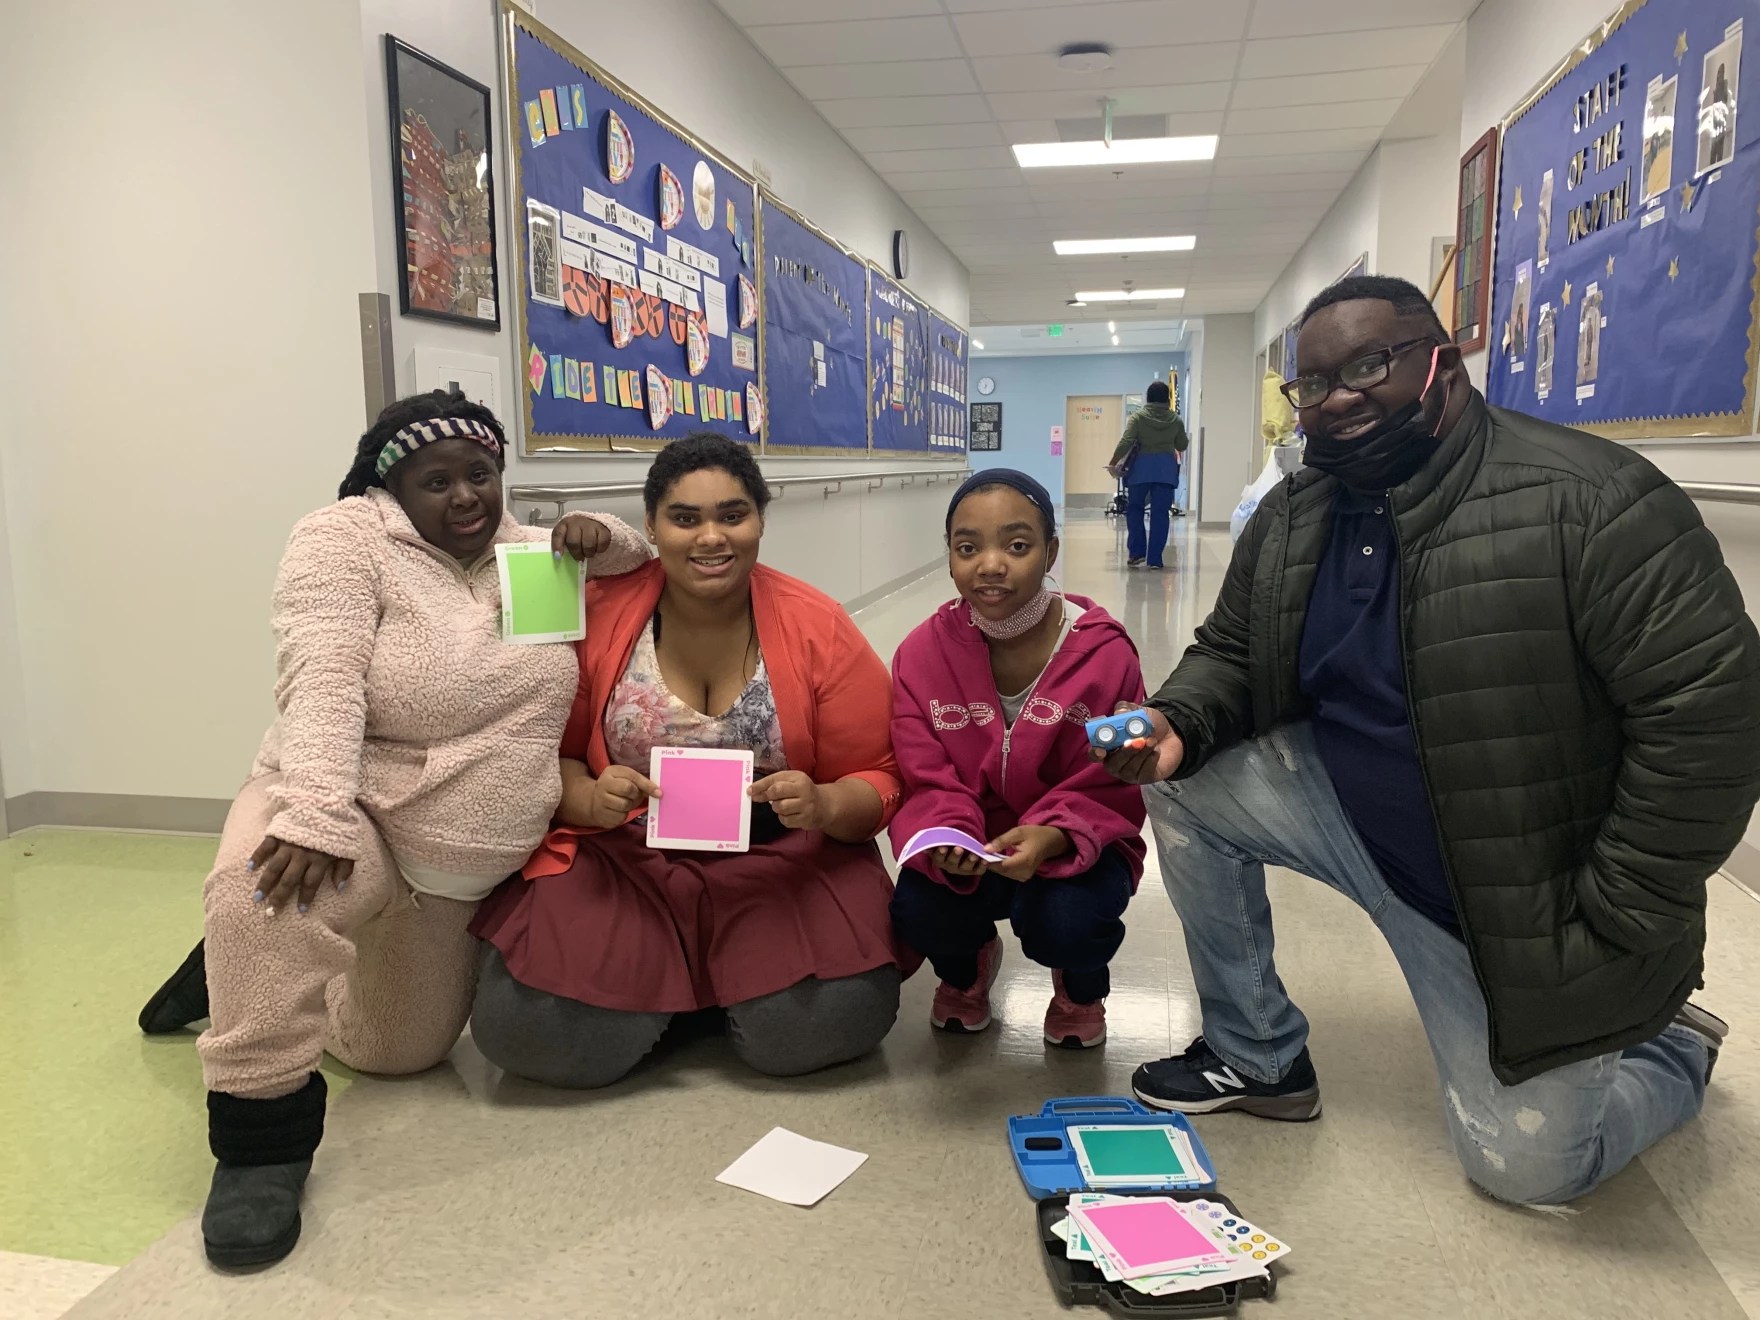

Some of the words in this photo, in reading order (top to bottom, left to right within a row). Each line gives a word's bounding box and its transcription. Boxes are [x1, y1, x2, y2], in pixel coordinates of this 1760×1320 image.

[1573, 63, 1628, 134] STAFF
[1567, 147, 1589, 191] OF
[1592, 121, 1624, 175] THE
[529, 352, 593, 397] RIDE
